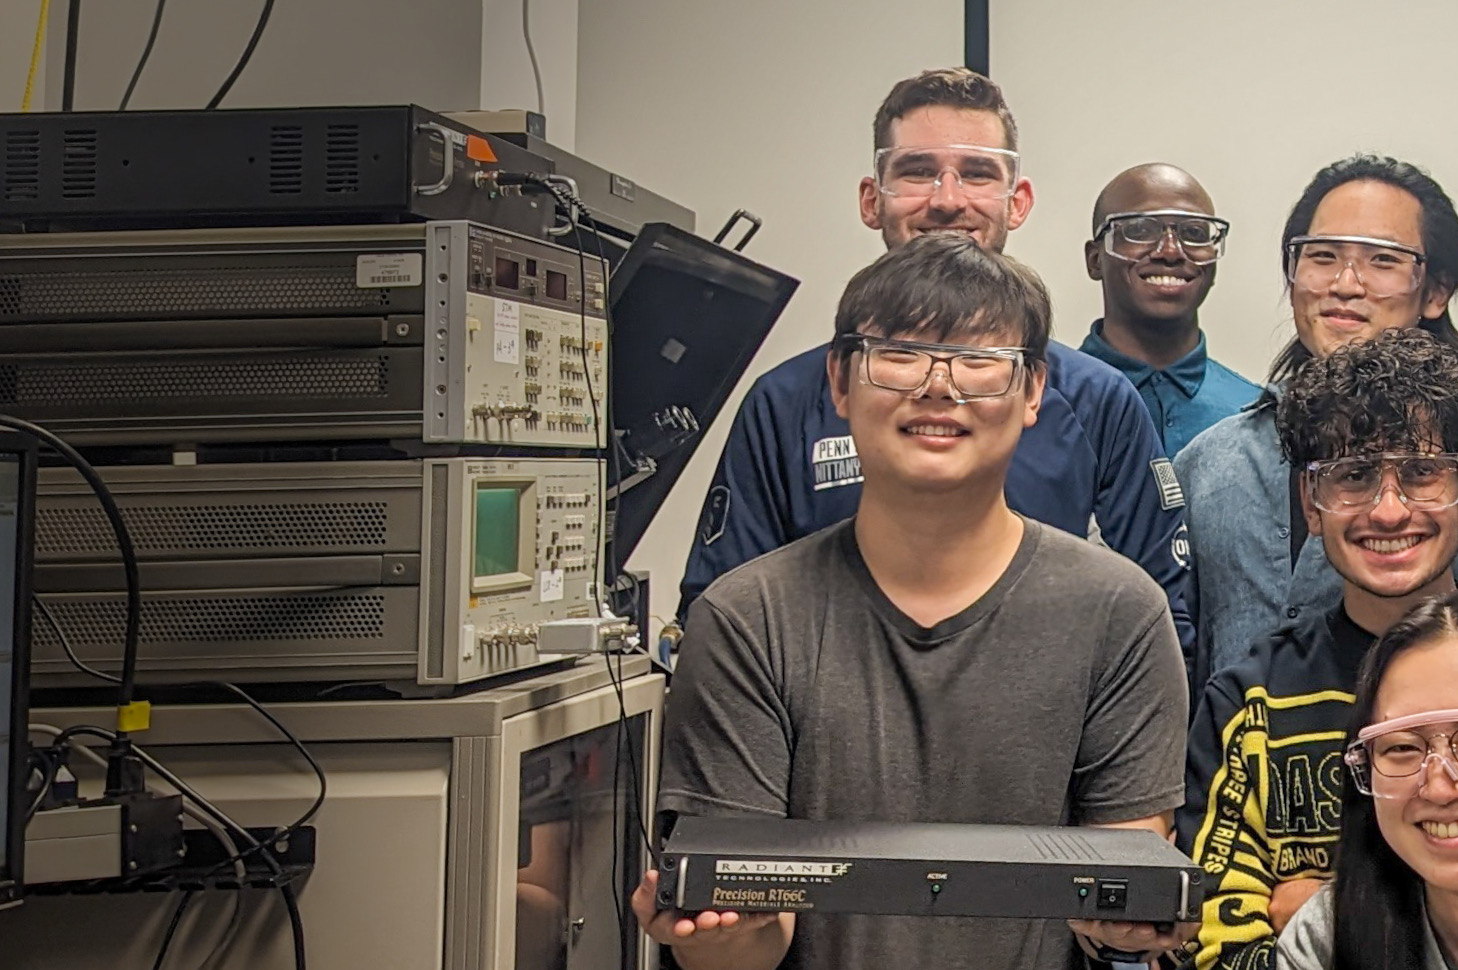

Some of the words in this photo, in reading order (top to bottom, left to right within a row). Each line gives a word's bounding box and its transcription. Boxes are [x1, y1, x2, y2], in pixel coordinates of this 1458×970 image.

[819, 439, 850, 459] PENN
[814, 457, 861, 483] NITTANY
[1204, 805, 1240, 874] STRIPES
[721, 863, 828, 873] RADIANT
[1279, 847, 1329, 872] BRAND
[713, 887, 765, 901] Precision
[768, 889, 806, 902] RT66C
